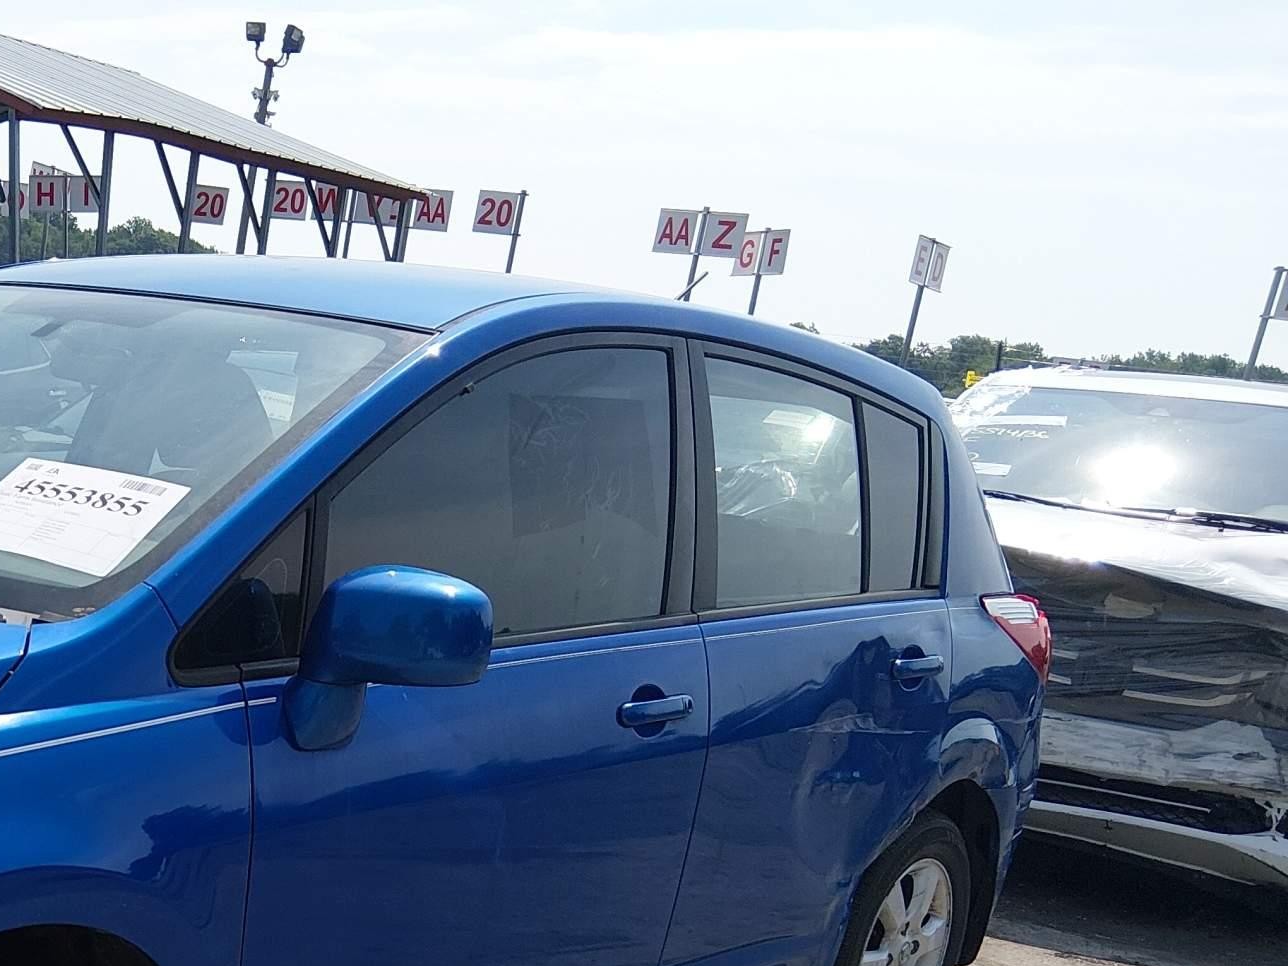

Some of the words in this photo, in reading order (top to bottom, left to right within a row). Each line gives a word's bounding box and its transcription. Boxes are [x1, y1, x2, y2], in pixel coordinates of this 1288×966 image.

[37, 182, 55, 206] H
[194, 191, 224, 219] 20
[273, 187, 305, 214] 20
[416, 196, 445, 225] AA
[476, 198, 513, 227] 20
[657, 216, 689, 246] AA
[712, 220, 737, 250] Z
[739, 240, 755, 268] G
[767, 238, 783, 267] F
[914, 245, 928, 276] E
[932, 252, 944, 281] D
[14, 478, 150, 516] 45553855
